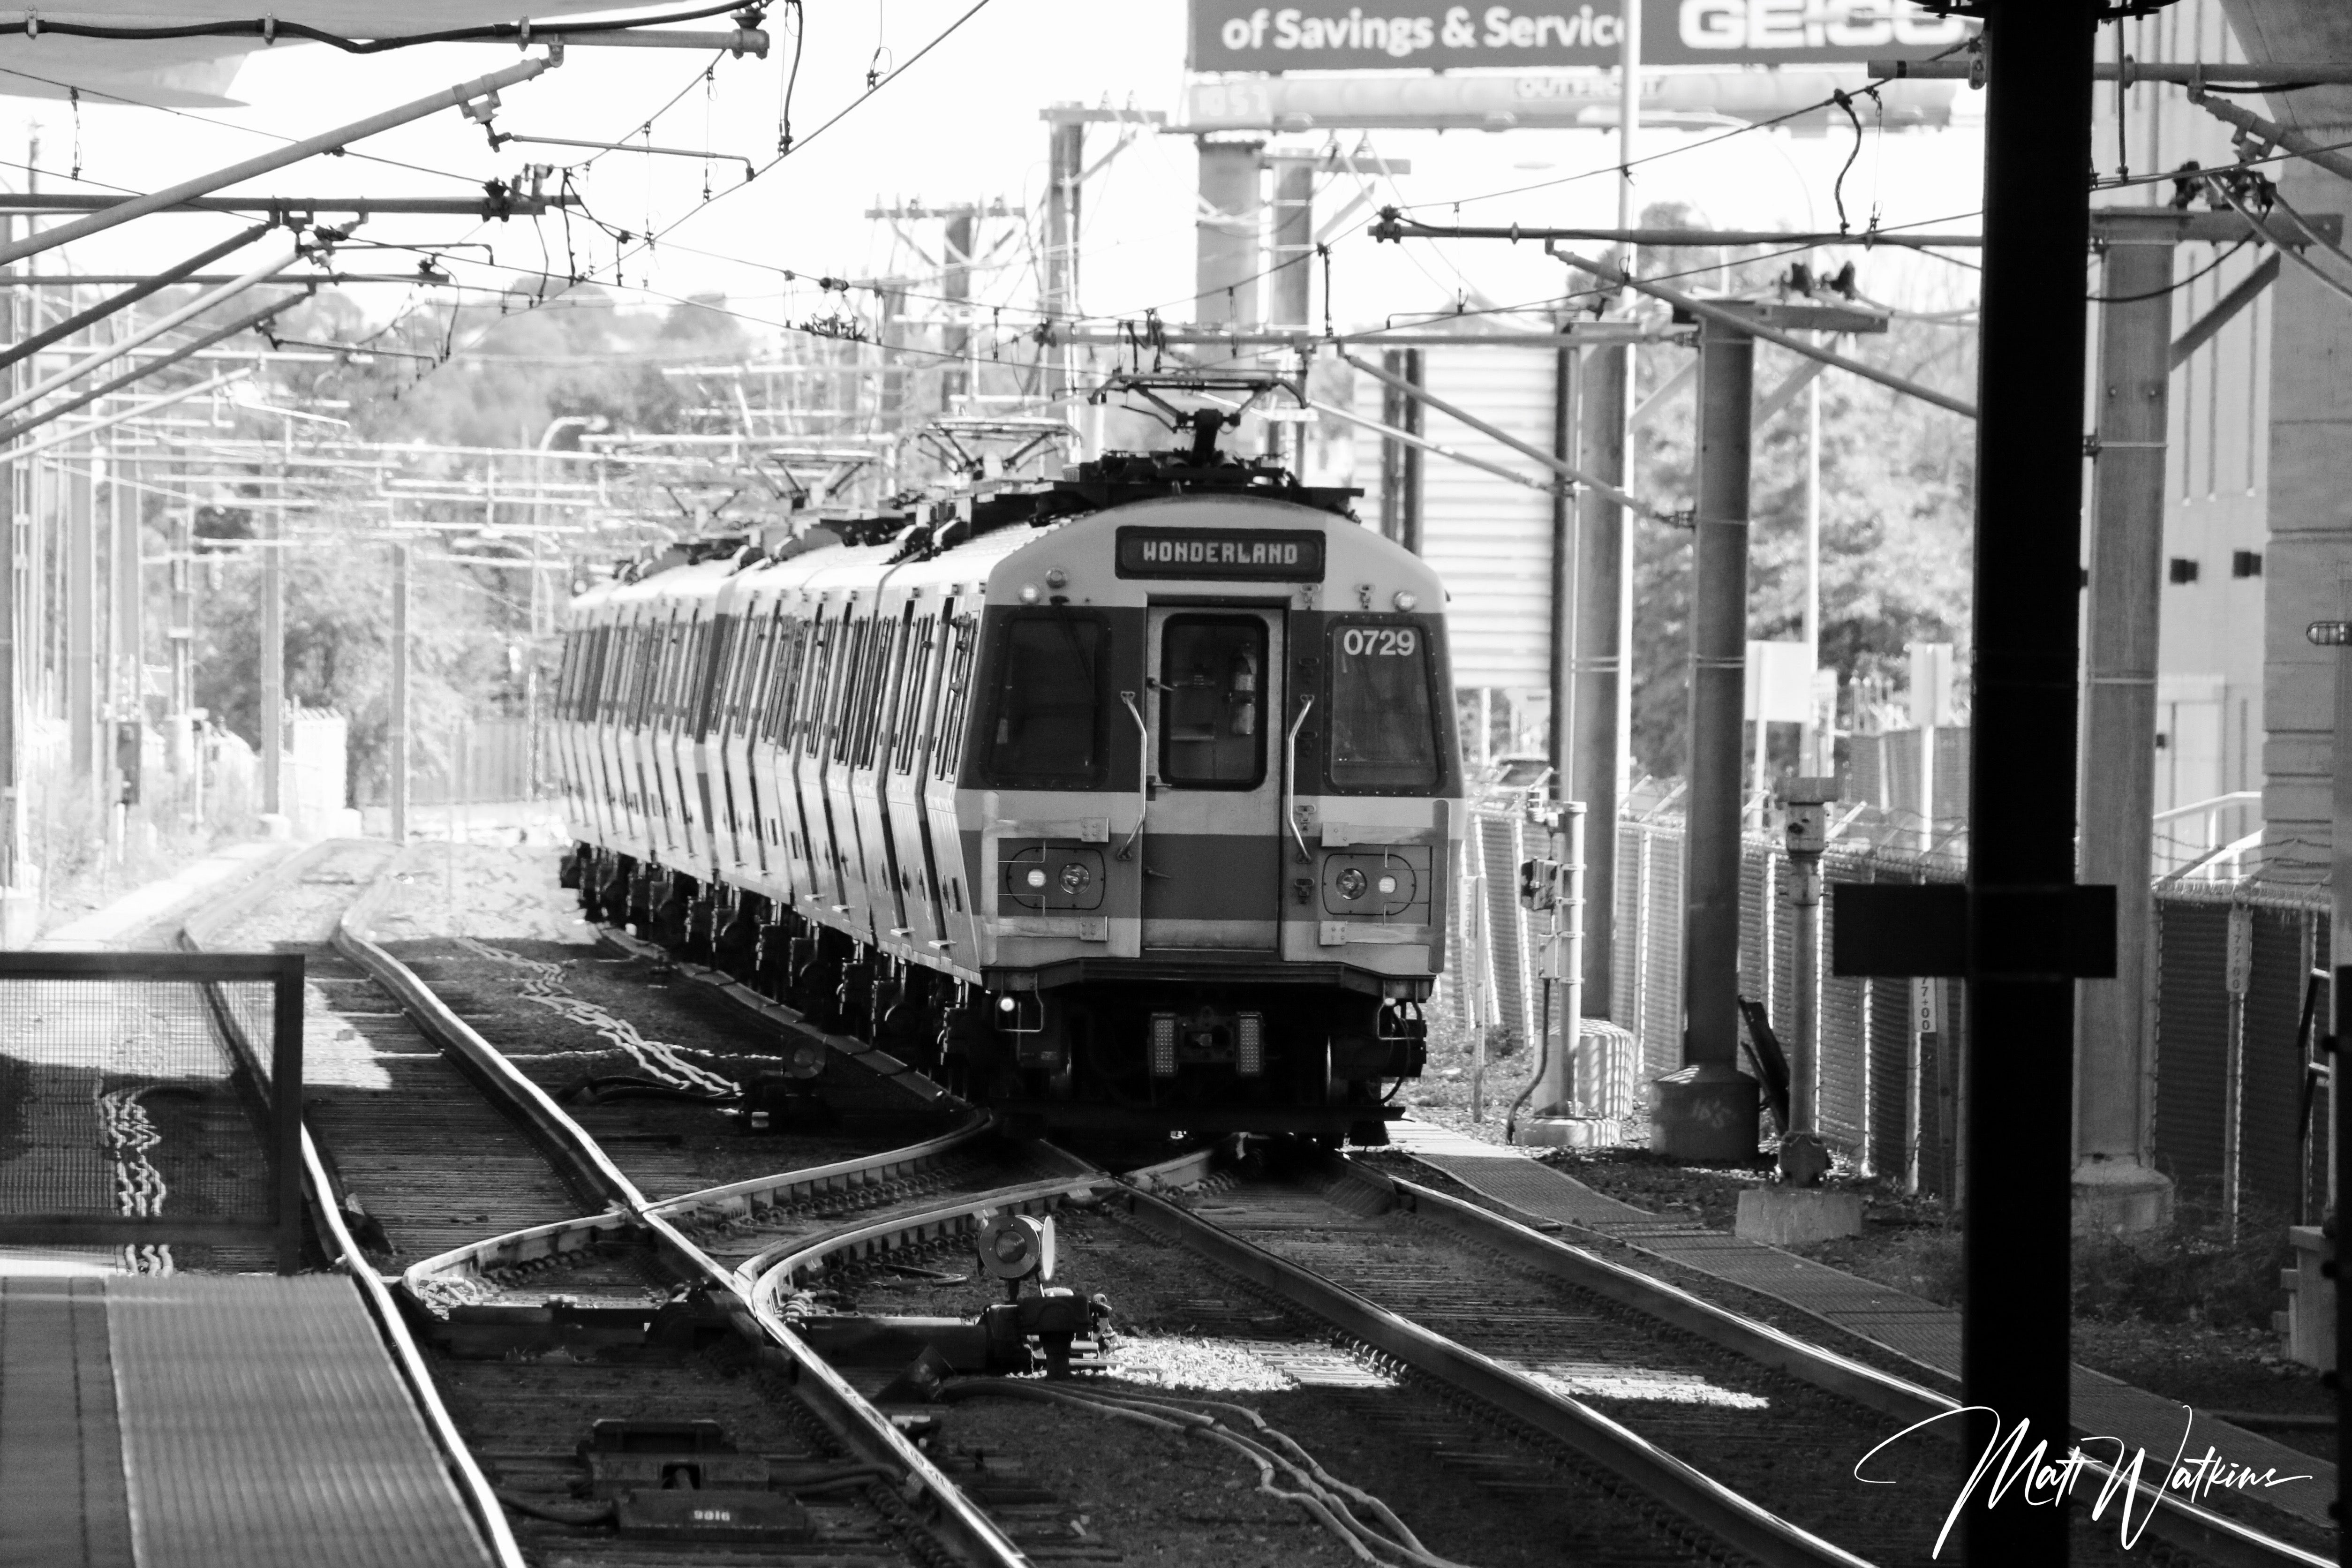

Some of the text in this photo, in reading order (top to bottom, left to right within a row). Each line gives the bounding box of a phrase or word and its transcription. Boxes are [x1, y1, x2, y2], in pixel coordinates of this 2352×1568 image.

[1222, 8, 1269, 50] of
[1274, 8, 1434, 57] Savings
[1441, 6, 1477, 48] &
[1143, 541, 1298, 565] WONDERLAND
[1342, 629, 1416, 656] 0729
